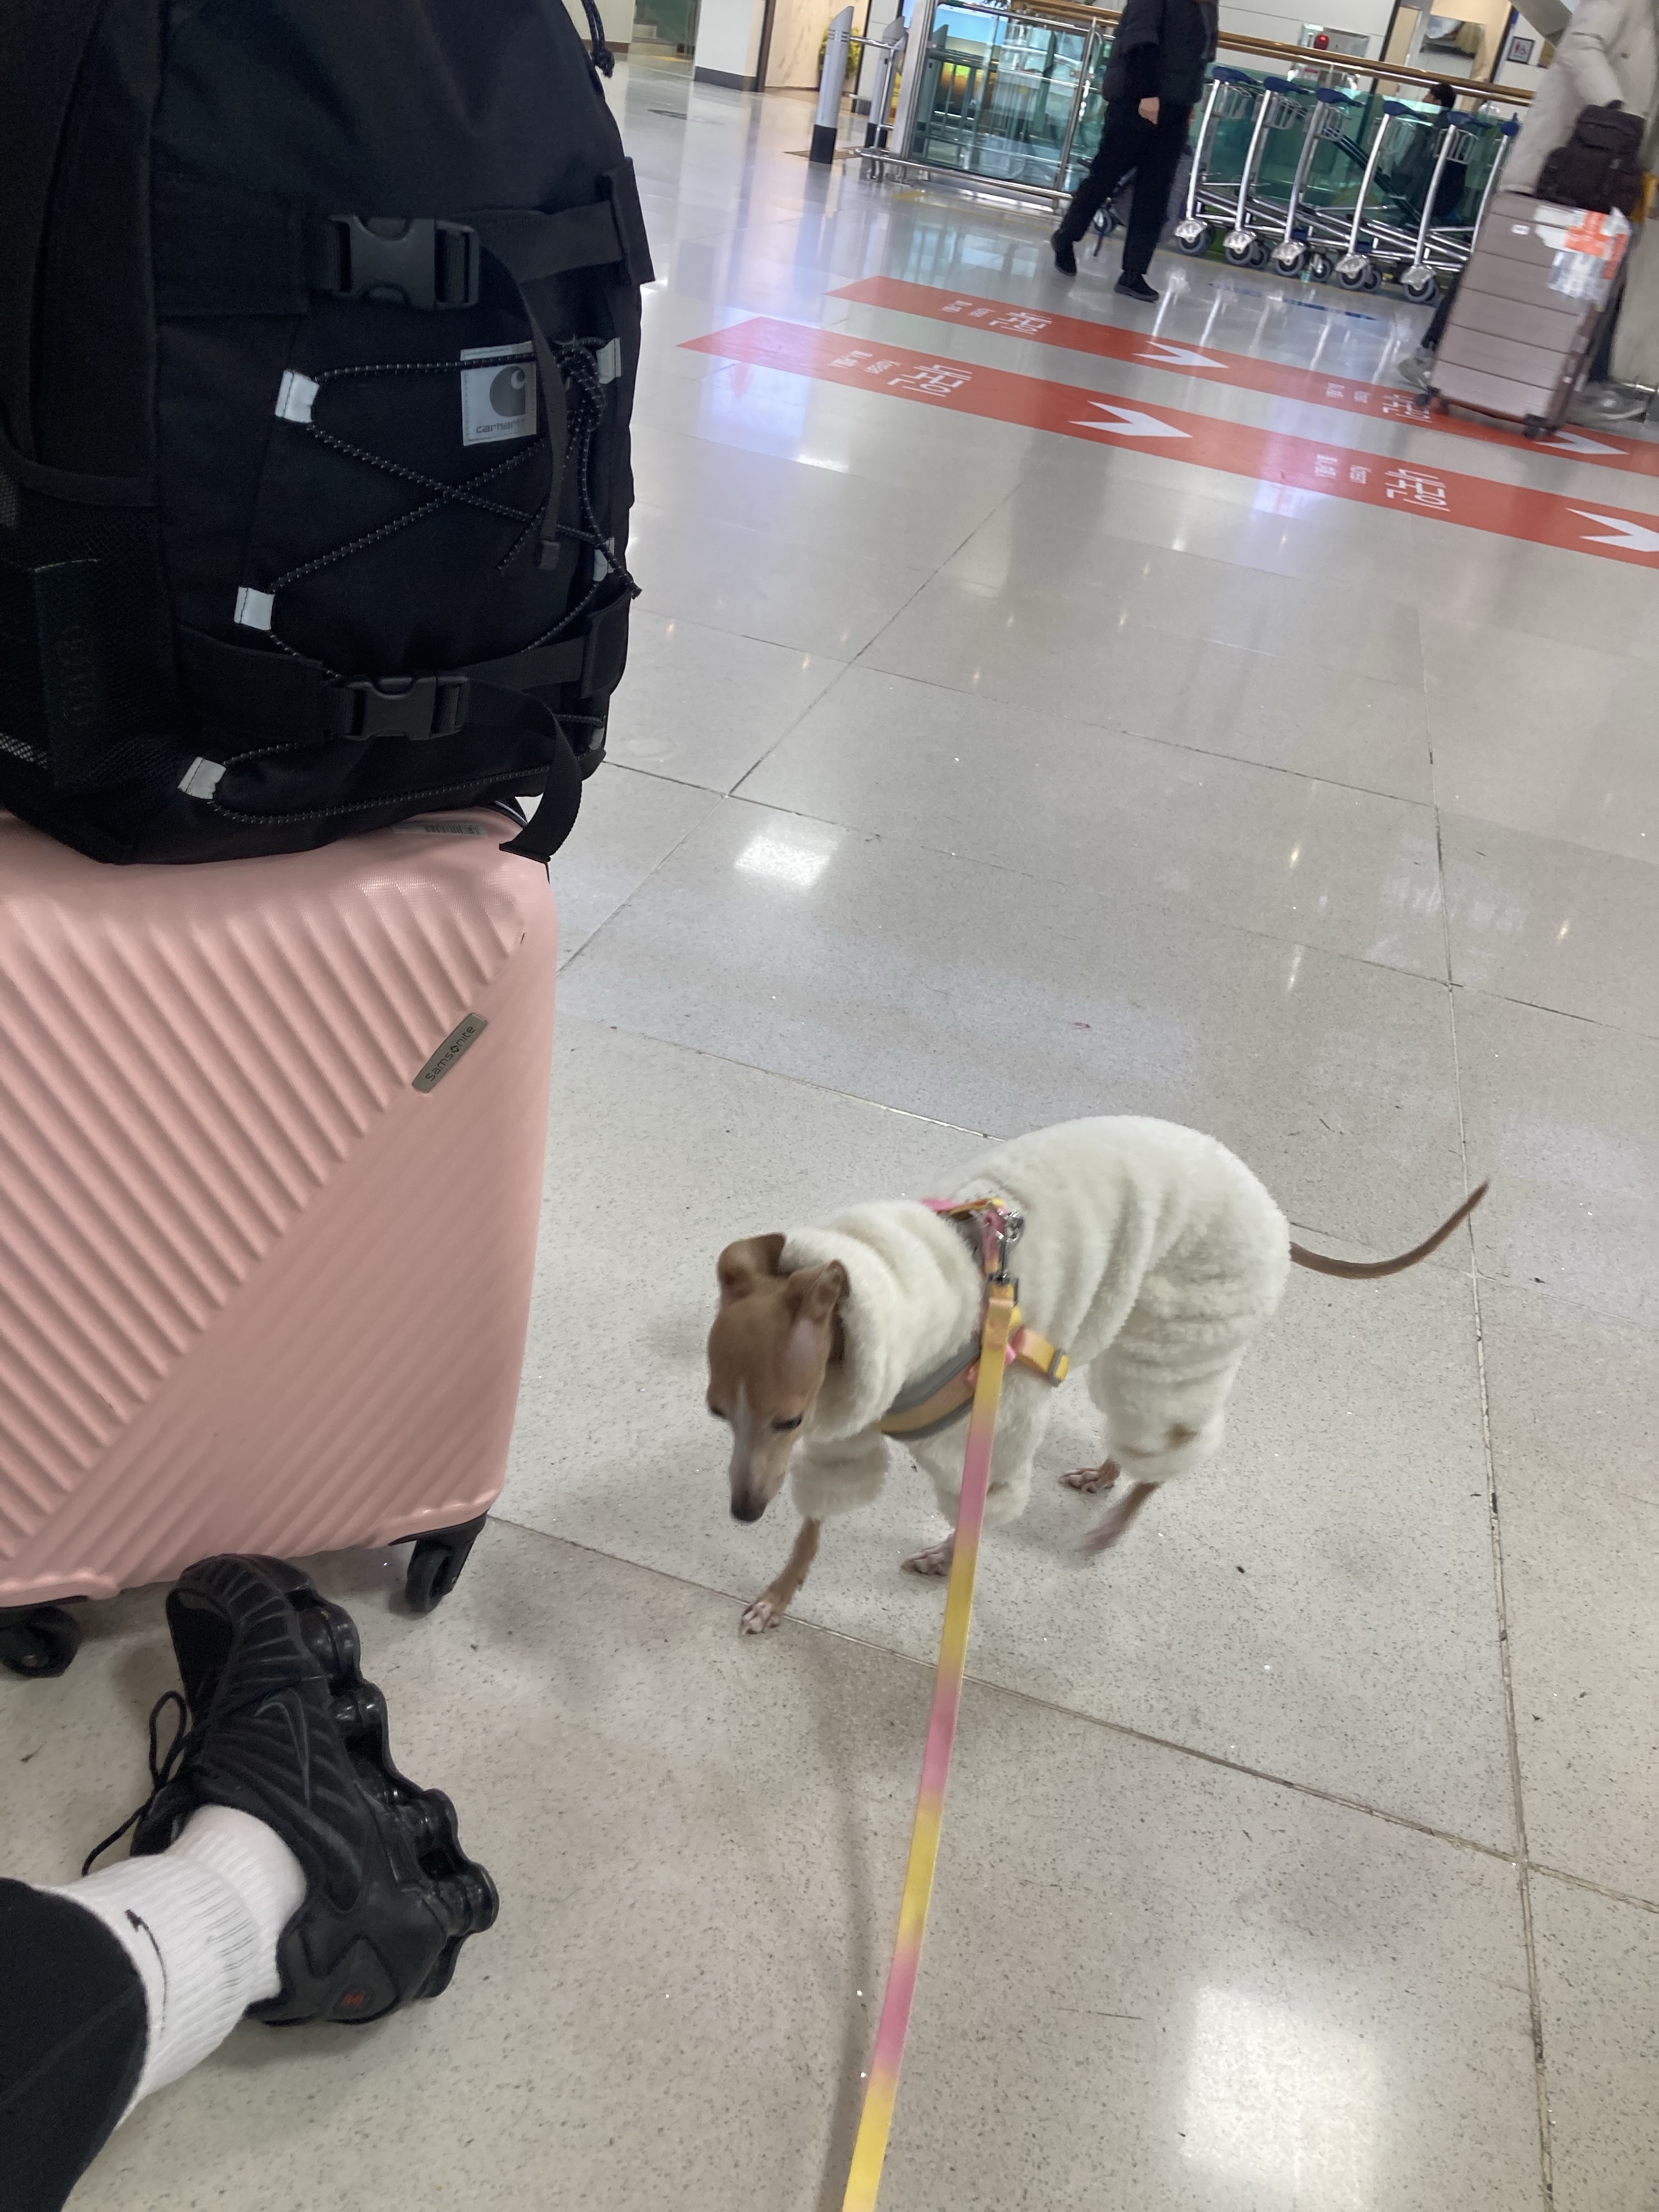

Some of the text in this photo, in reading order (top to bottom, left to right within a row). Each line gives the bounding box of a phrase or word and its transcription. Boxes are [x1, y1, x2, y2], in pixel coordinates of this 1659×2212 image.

[988, 312, 1053, 335] 내국인
[887, 364, 973, 398] 내국인
[1384, 468, 1451, 512] 내국인
[425, 1026, 475, 1082] Samsonite
